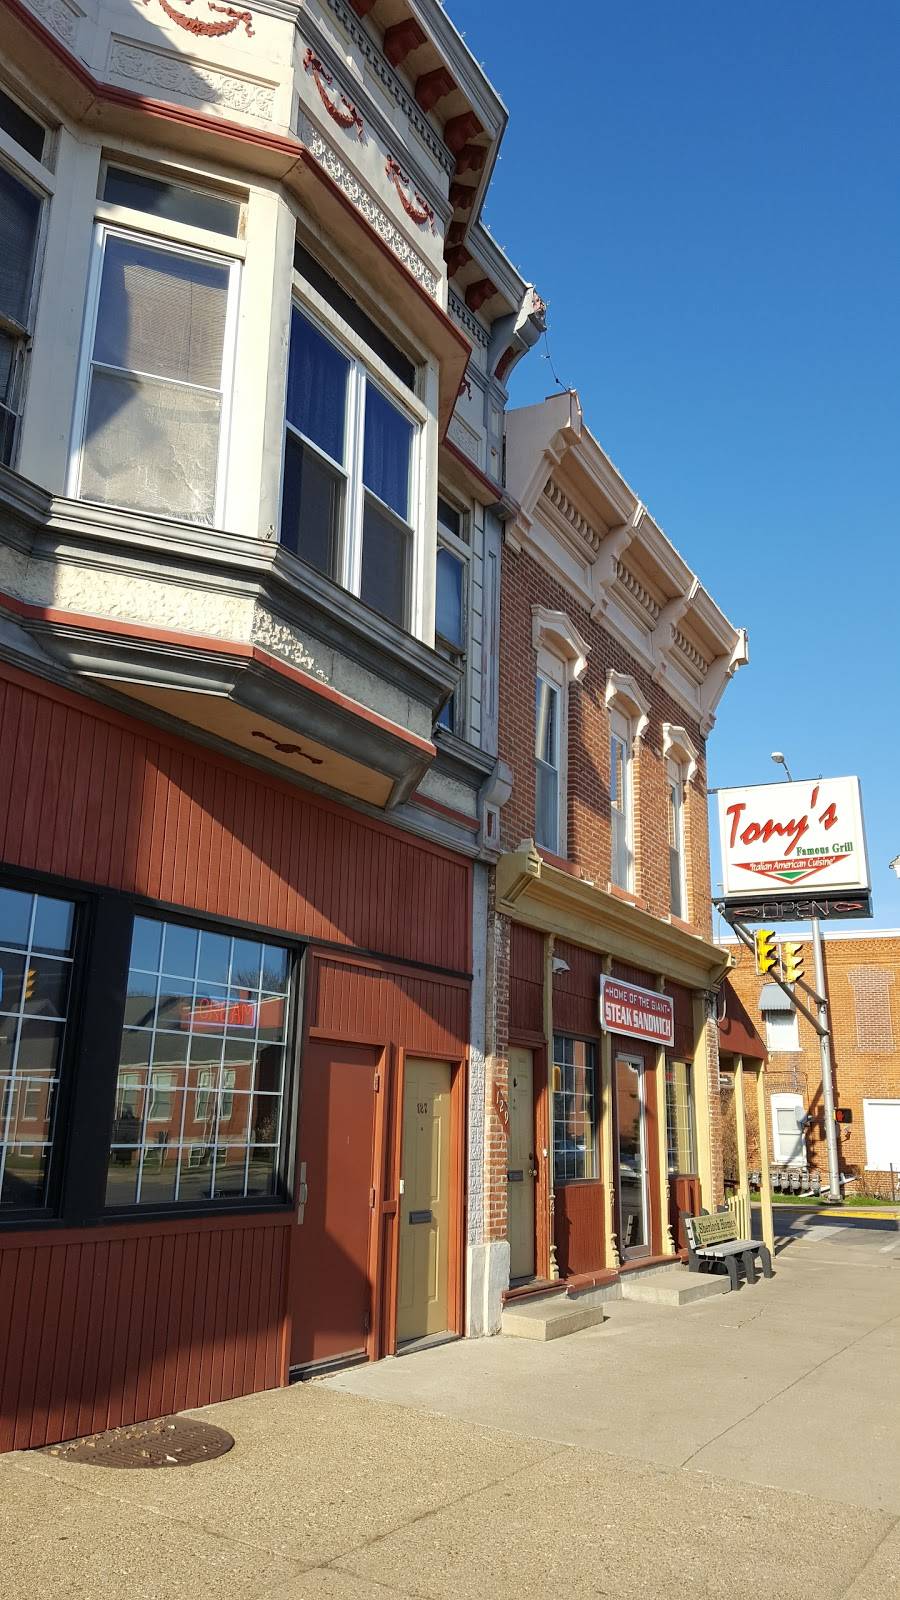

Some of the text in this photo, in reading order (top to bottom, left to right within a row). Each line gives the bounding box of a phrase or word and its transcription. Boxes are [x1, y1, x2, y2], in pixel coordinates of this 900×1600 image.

[726, 786, 838, 857] Tony's
[796, 841, 853, 857] Famous Grill
[773, 859, 806, 870] American
[762, 900, 830, 918] OPEN
[608, 987, 668, 1014] HOME OF THE GIANT
[605, 1002, 671, 1037] STEAK SANDWICH
[496, 1090, 509, 1125] 129
